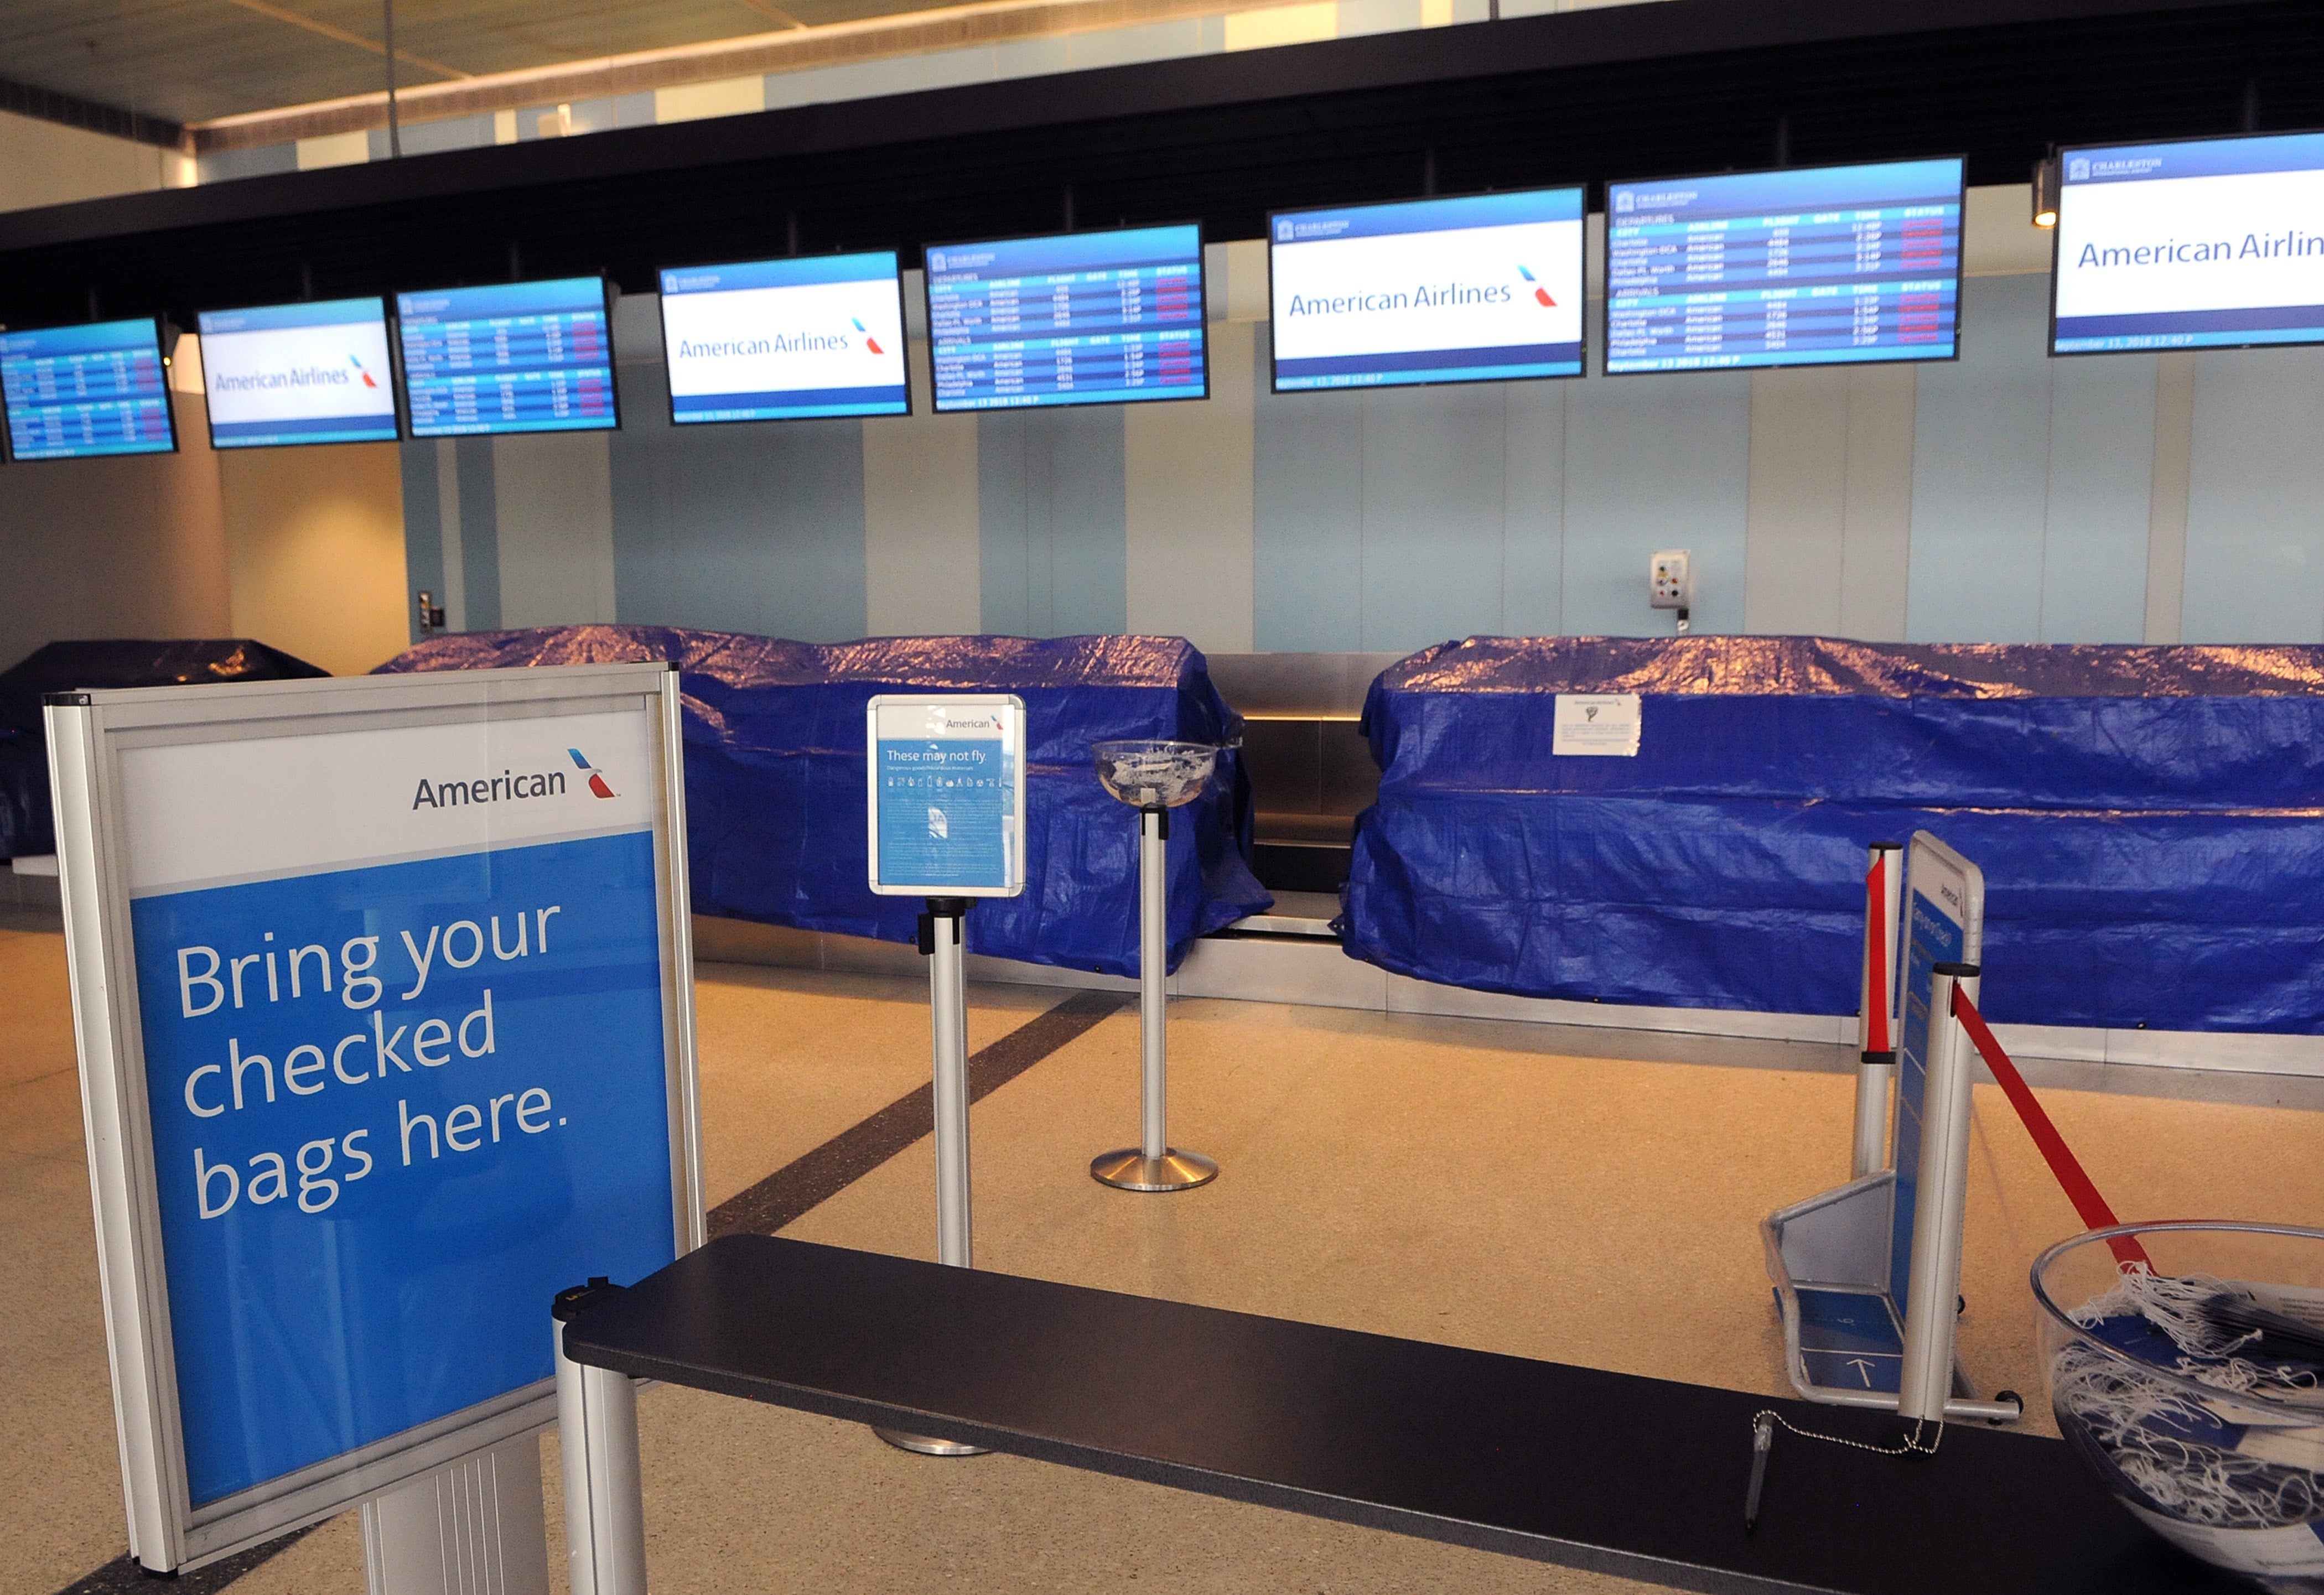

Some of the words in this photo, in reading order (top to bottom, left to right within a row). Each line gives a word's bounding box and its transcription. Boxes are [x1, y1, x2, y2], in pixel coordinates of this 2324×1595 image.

[2079, 238, 2231, 268] American
[1290, 292, 1407, 316] American
[1414, 283, 1511, 307] Airlines
[680, 337, 770, 359] American
[775, 332, 848, 352] Airlines
[216, 371, 288, 393] American
[290, 366, 350, 386] Airlines
[946, 719, 989, 728] American
[888, 750, 920, 761] These
[922, 751, 946, 764] may
[950, 751, 969, 761] not
[972, 750, 987, 764] fly.
[413, 767, 566, 810] American
[177, 932, 382, 1018] Bring
[401, 905, 561, 1000] your
[185, 989, 496, 1118] checked
[193, 1129, 372, 1220] bags
[398, 1087, 567, 1166] here.
